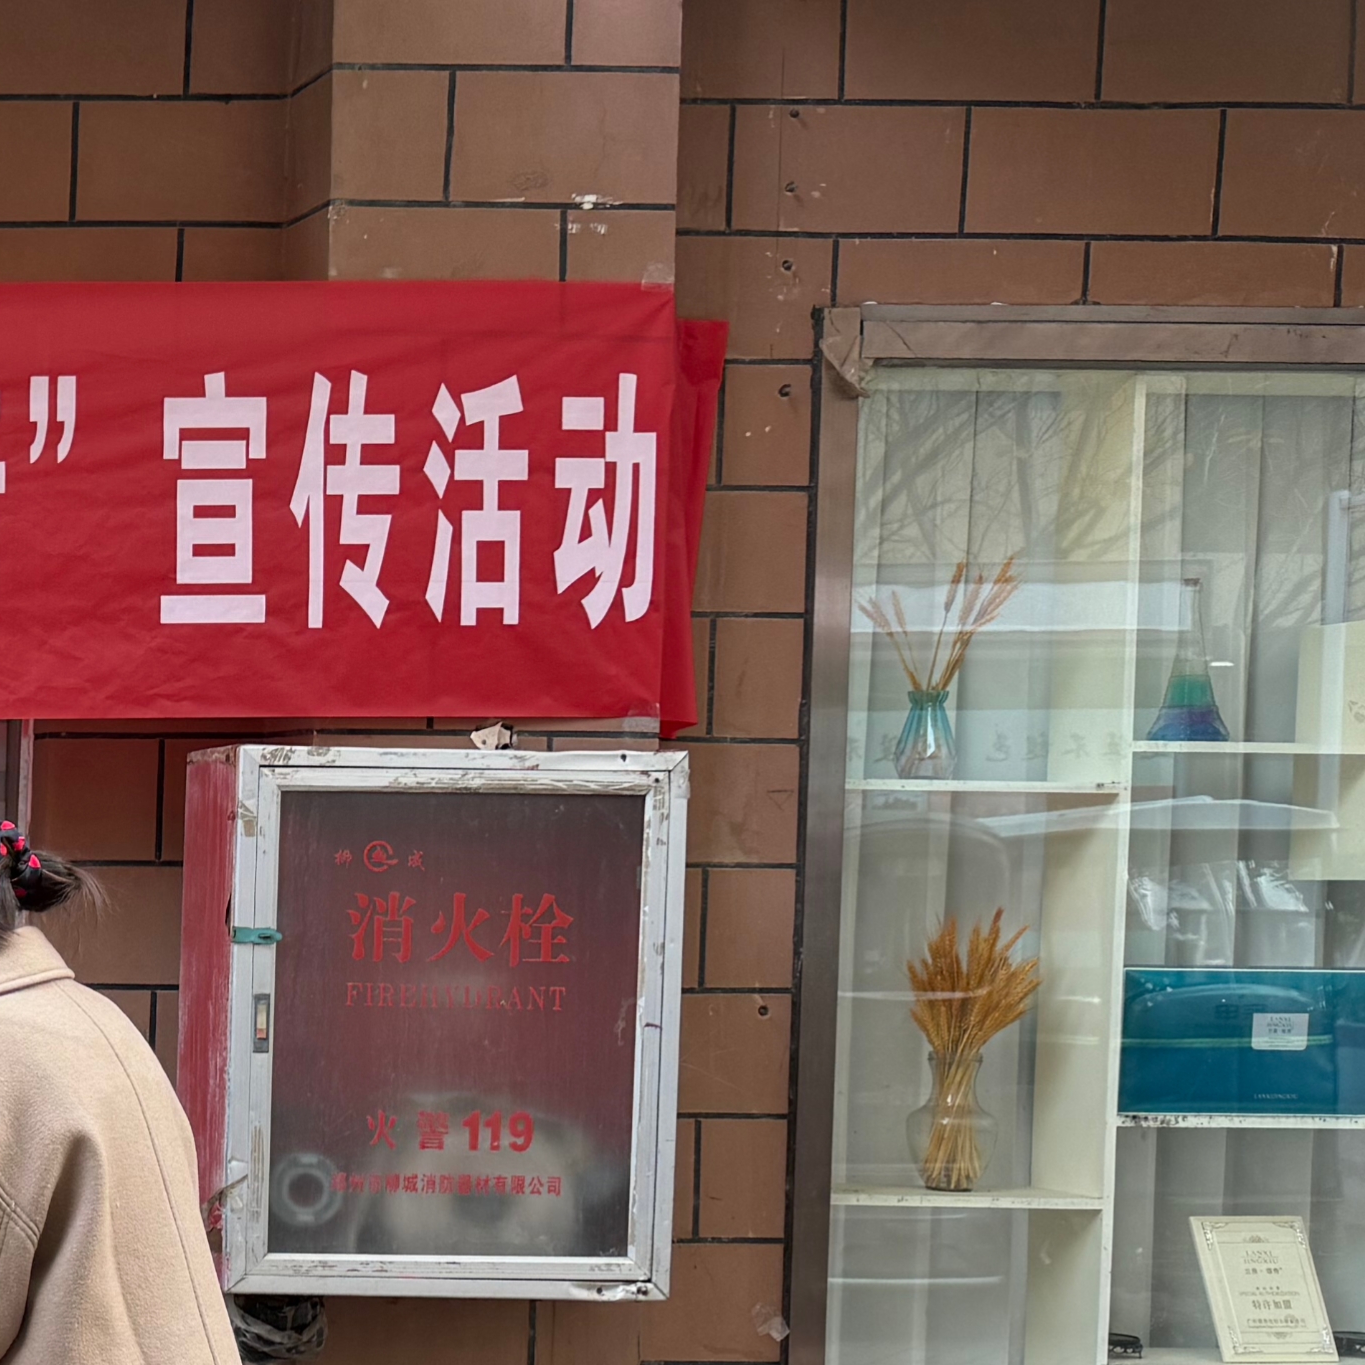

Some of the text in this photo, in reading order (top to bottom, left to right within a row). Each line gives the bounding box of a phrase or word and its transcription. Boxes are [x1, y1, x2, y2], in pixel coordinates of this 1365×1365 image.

[346, 890, 575, 967] 消火栓
[344, 981, 567, 1012] FIREHYDRANT
[461, 1109, 535, 1153] 119
